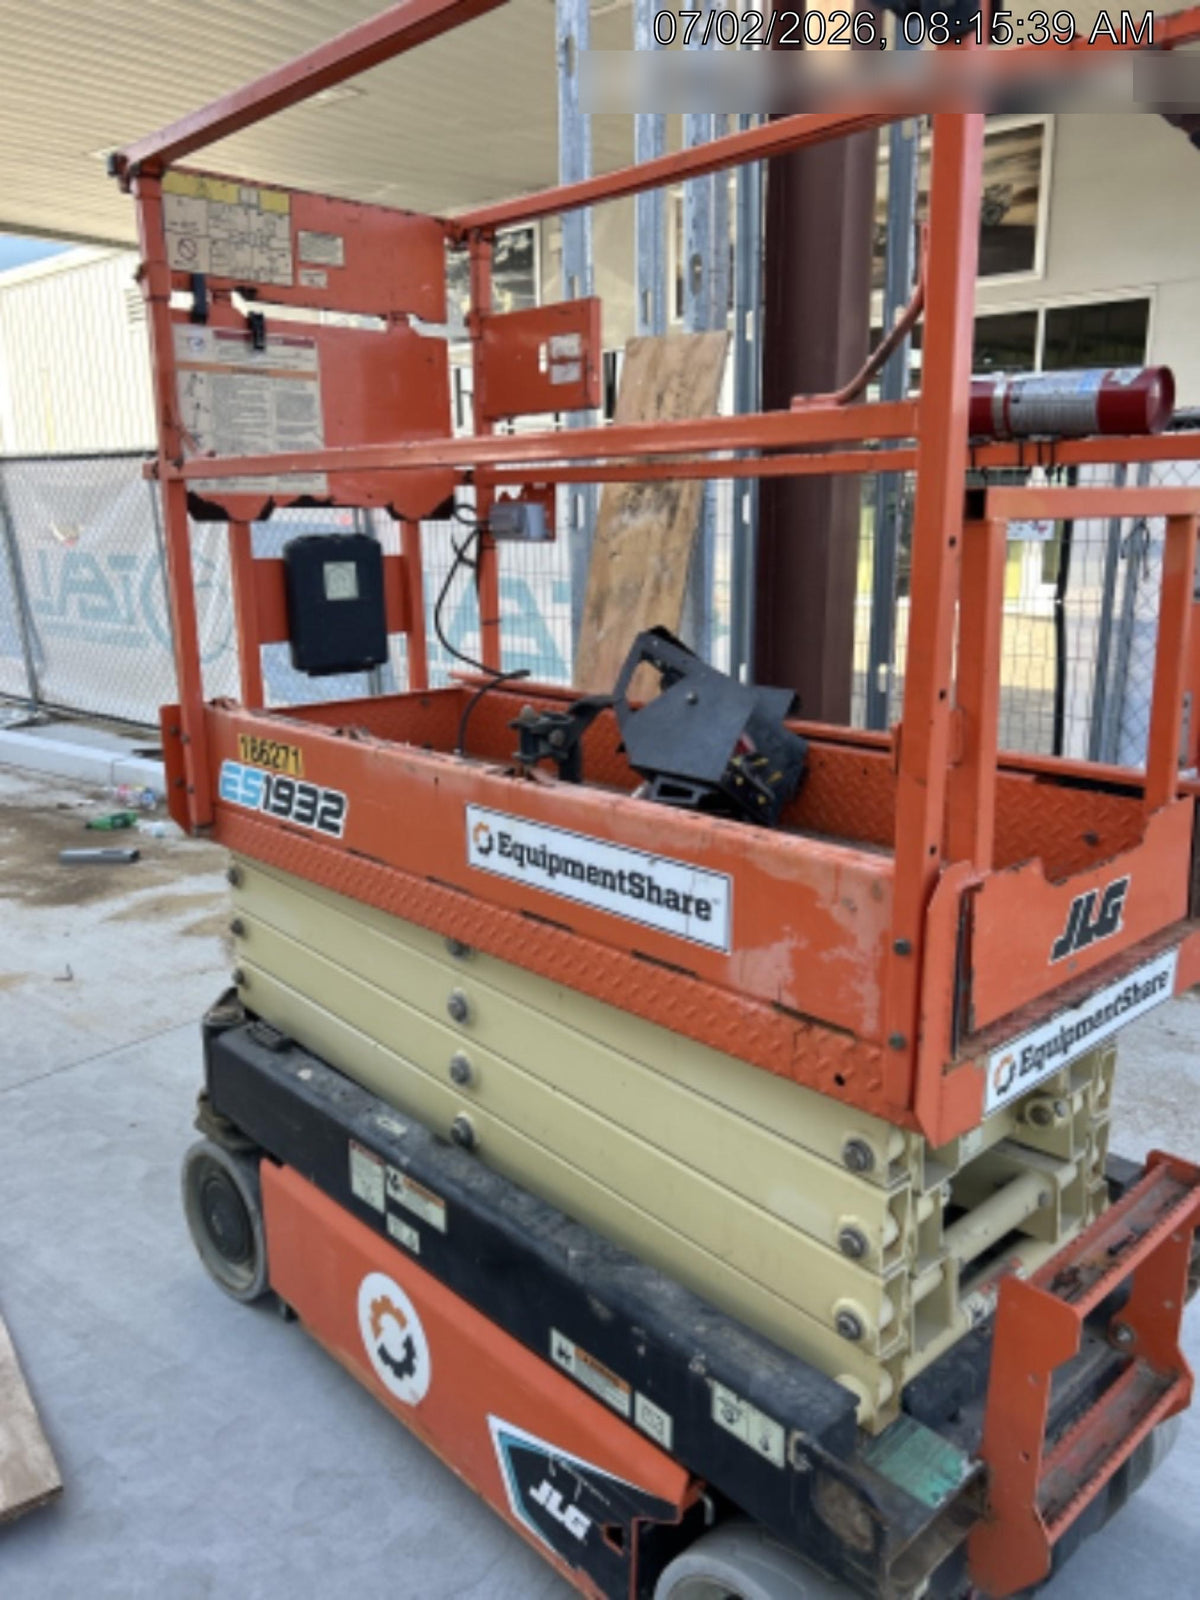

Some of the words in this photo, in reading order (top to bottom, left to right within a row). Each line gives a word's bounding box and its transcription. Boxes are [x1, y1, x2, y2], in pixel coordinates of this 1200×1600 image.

[221, 761, 345, 838] ES1932
[497, 831, 712, 922] EquipmentShare
[1050, 876, 1130, 962] JLG
[1019, 969, 1170, 1078] EquipmentShare
[529, 1478, 592, 1541] JLG
